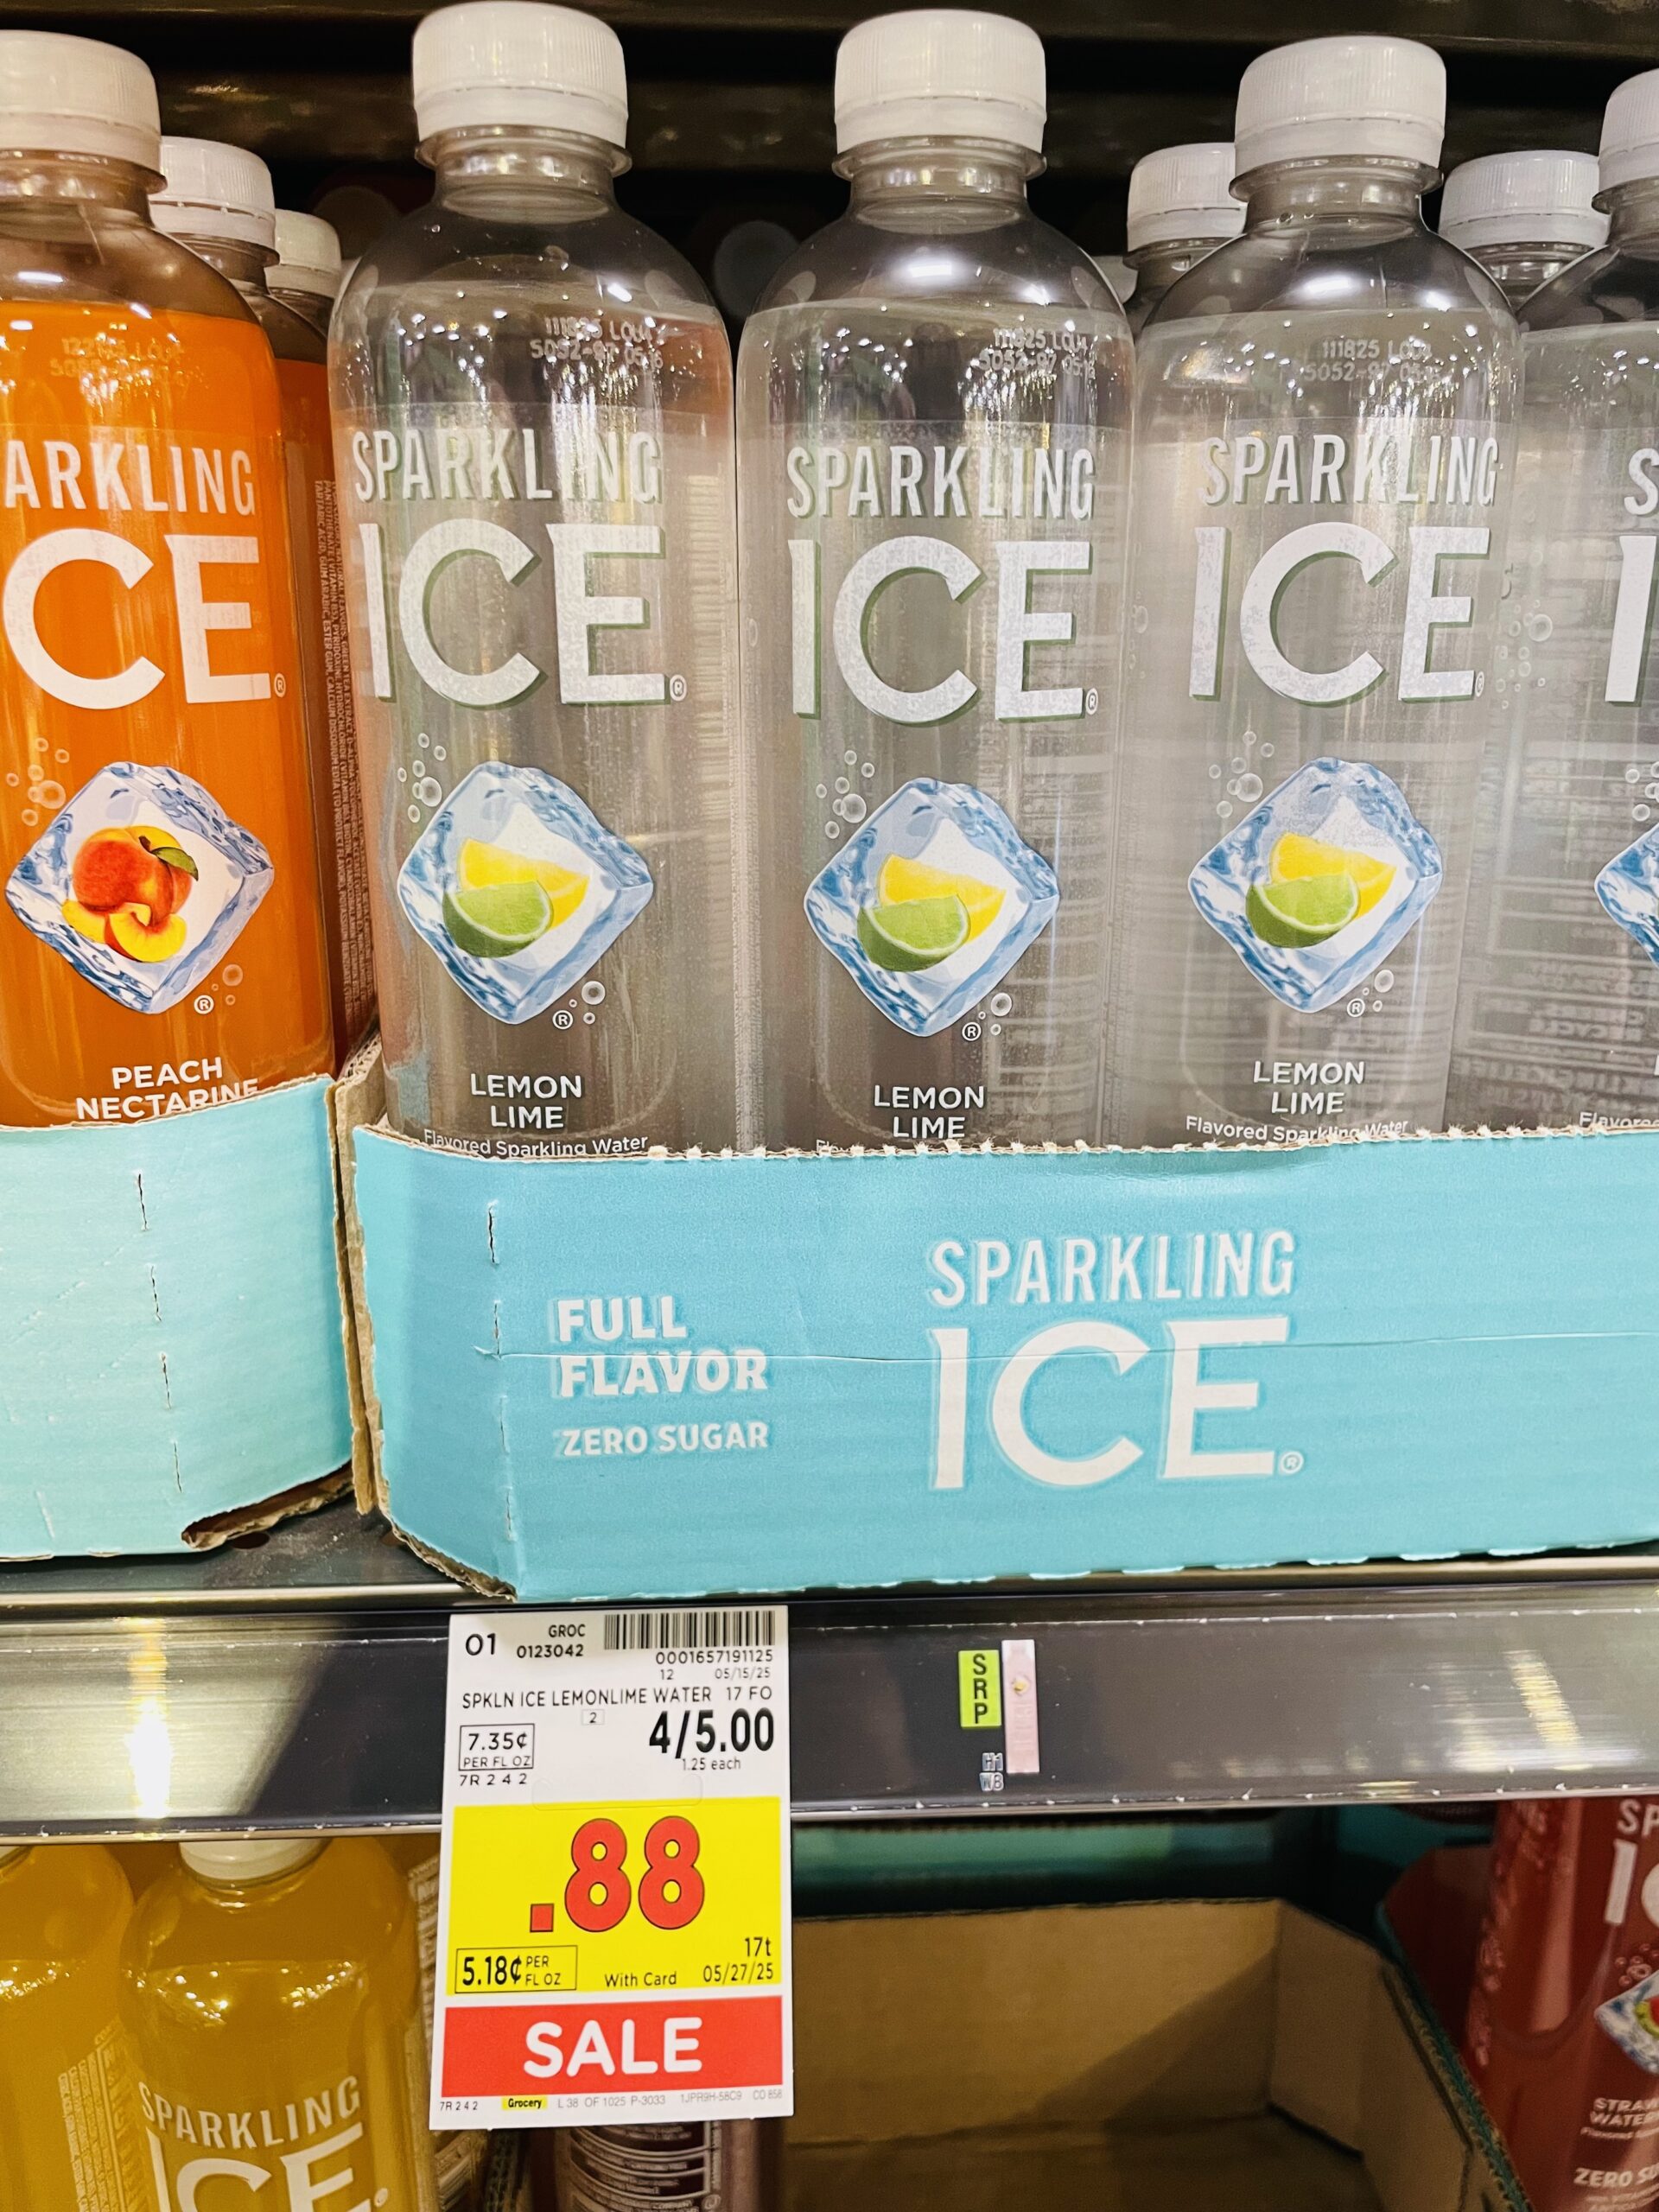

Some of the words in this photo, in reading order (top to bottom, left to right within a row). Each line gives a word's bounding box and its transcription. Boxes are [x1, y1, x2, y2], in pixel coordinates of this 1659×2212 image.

[352, 427, 662, 505] SPARKLING
[1197, 434, 1500, 508] SPARKLING
[786, 444, 1096, 521] SPARKLING
[111, 1056, 223, 1090] PEACH
[1252, 1059, 1365, 1085] LEMON
[470, 1072, 582, 1100] LEMON
[874, 1084, 985, 1110] LEMON
[75, 1077, 258, 1121] NECTARINE
[1270, 1091, 1344, 1115] LIME
[490, 1104, 565, 1129] LIME
[893, 1116, 966, 1140] LIME
[1185, 1116, 1268, 1141] Flavored
[423, 1128, 491, 1154] Flavored
[496, 1140, 588, 1158] Sparkling
[592, 1135, 648, 1154] Water
[931, 1230, 1294, 1306] SPARKLING
[557, 1295, 687, 1342] FULL
[558, 1349, 768, 1397] FLAVOR
[562, 1427, 647, 1457] ZERO
[657, 1421, 769, 1452] SUGAR
[548, 1624, 586, 1638] GROC
[516, 1643, 584, 1659] 0123042
[655, 1649, 773, 1665] 0001657191125
[660, 1669, 674, 1681] 12
[715, 1667, 772, 1681] 05/15/25
[462, 1690, 514, 1709] SPKLN
[520, 1691, 545, 1707] ICE
[552, 1688, 647, 1707] LEMONLIME
[653, 1686, 712, 1703] WATER
[726, 1686, 741, 1701] 17
[749, 1685, 772, 1700] FO
[588, 1711, 598, 1725] 2
[649, 1707, 775, 1759] 4/5.00
[463, 1757, 488, 1768] PER
[493, 1756, 507, 1768] FL
[512, 1755, 531, 1767] OZ
[682, 1758, 707, 1771] 1.25
[710, 1757, 741, 1770] each
[529, 1815, 705, 1934] .88
[525, 1955, 549, 1968] PER
[702, 1961, 774, 1984] 05/27/25
[525, 1974, 540, 1986] FL
[543, 1974, 561, 1986] OZ
[604, 1973, 638, 1988] With
[644, 1971, 677, 1987] Card
[523, 2016, 703, 2079] SALE
[138, 2075, 361, 2149] SPARKLING
[507, 2097, 543, 2110] Grocery
[584, 2096, 600, 2107] OF
[603, 2096, 626, 2107] 1025
[1573, 2167, 1633, 2188] ZERO
